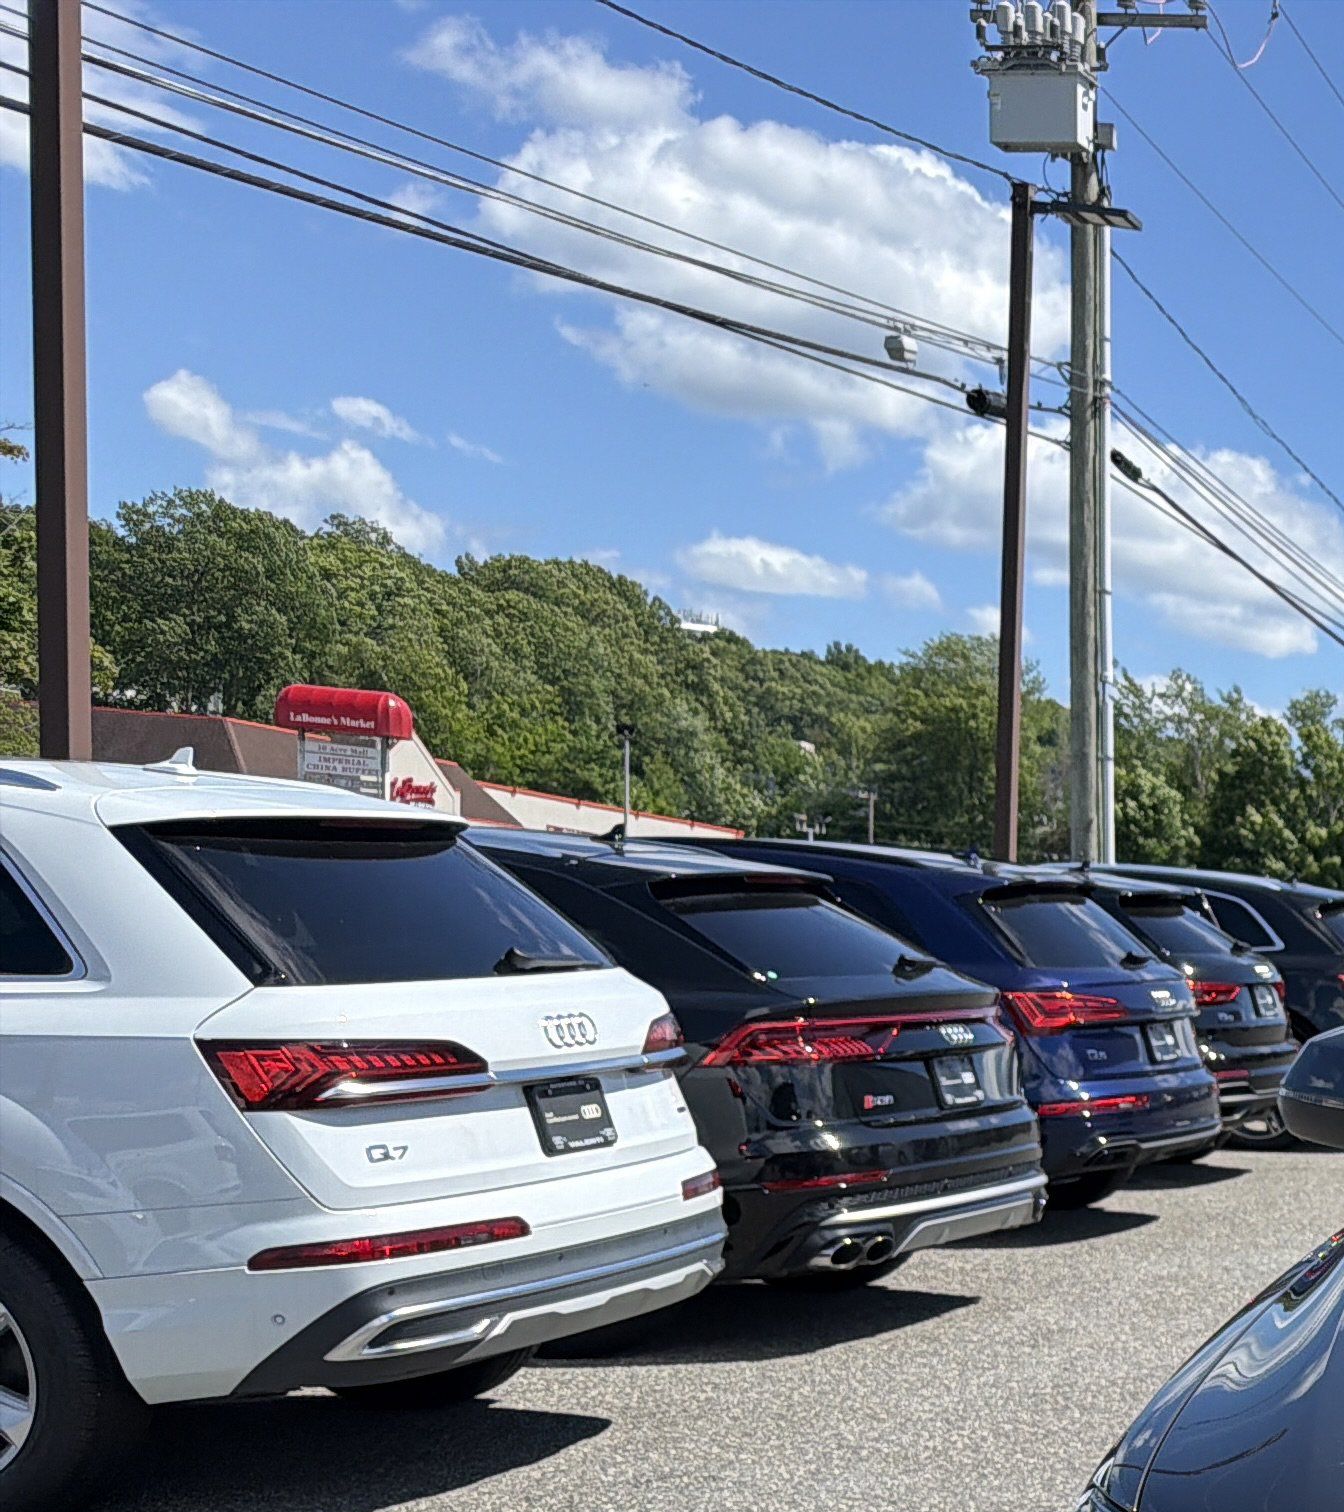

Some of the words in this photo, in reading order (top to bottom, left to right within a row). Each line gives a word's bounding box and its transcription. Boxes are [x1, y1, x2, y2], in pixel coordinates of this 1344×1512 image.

[340, 716, 375, 729] Market
[318, 755, 369, 767] IMPERIAL
[306, 763, 338, 773] CHINA
[365, 1144, 409, 1163] Q7
